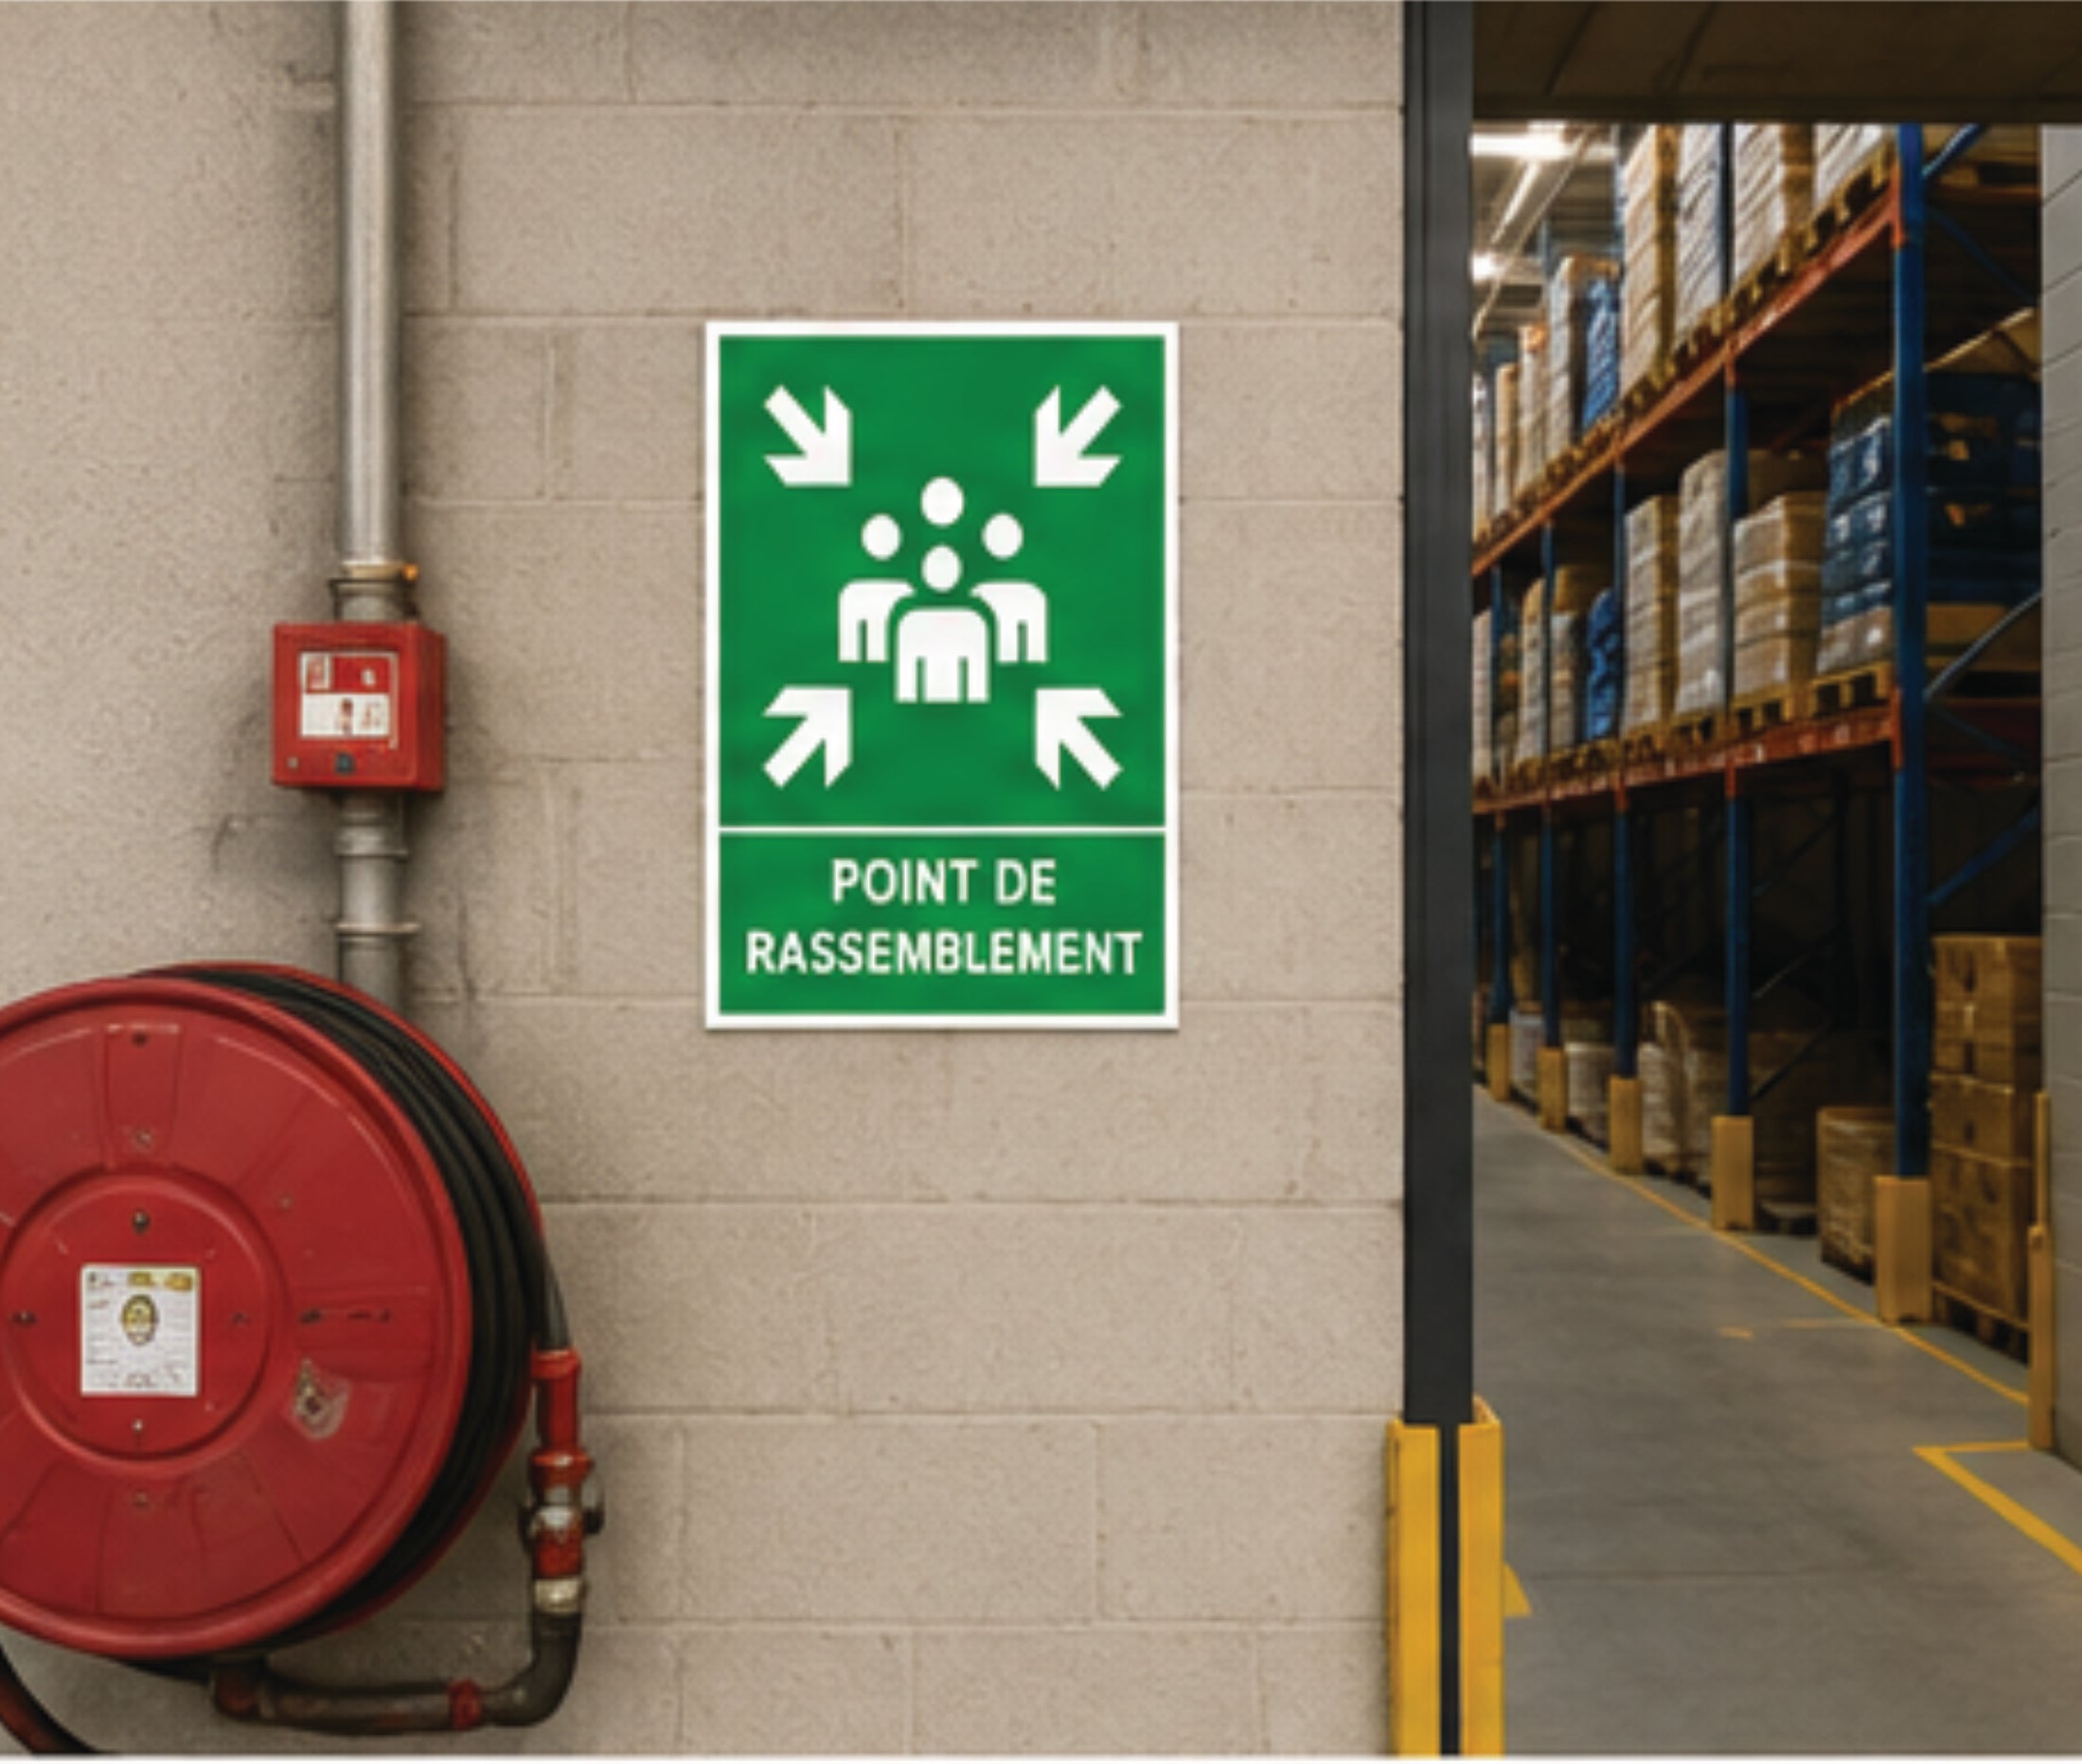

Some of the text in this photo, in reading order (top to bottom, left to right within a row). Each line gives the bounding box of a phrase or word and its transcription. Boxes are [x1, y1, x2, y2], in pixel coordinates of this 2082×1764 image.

[831, 858, 1057, 905] POINT DE
[745, 929, 1144, 975] RASSEMBLEMENT
